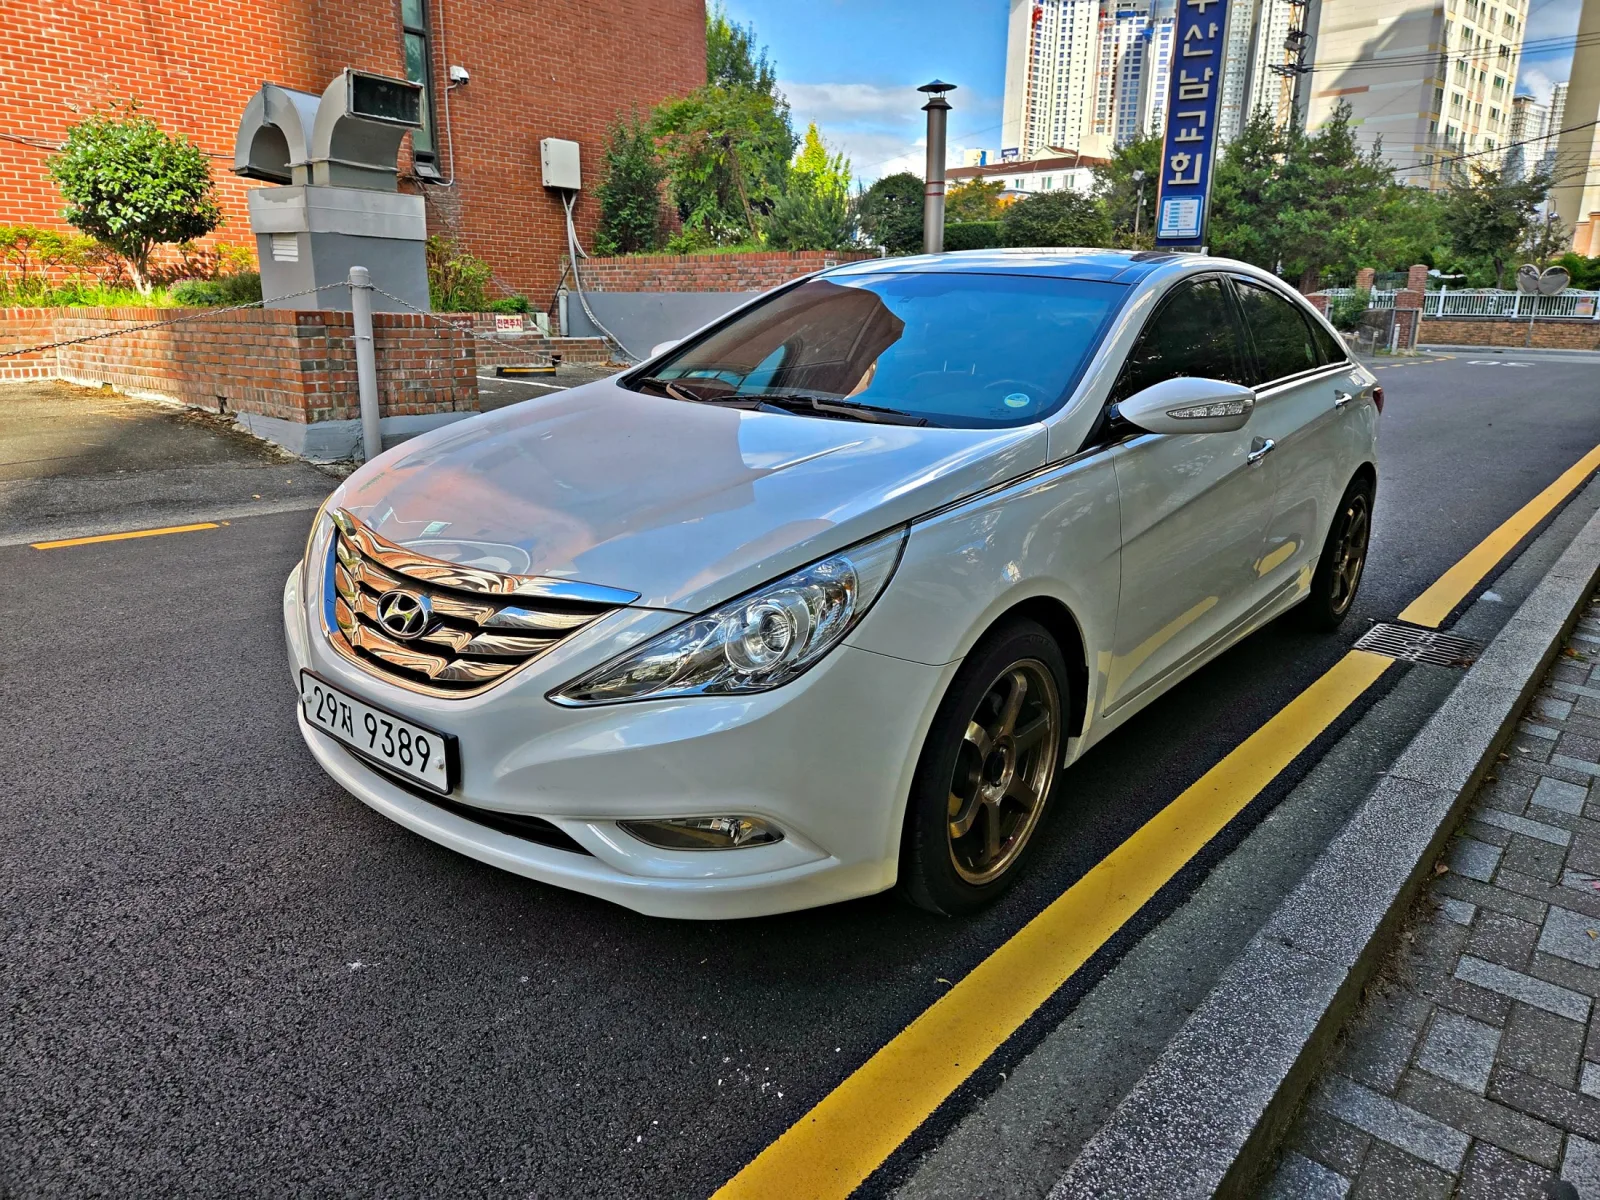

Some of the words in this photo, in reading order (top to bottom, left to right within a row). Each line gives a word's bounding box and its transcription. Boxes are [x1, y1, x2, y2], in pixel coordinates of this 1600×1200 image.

[497, 318, 523, 329] 전면주차
[314, 685, 354, 738] 29저
[364, 712, 431, 773] 9389
